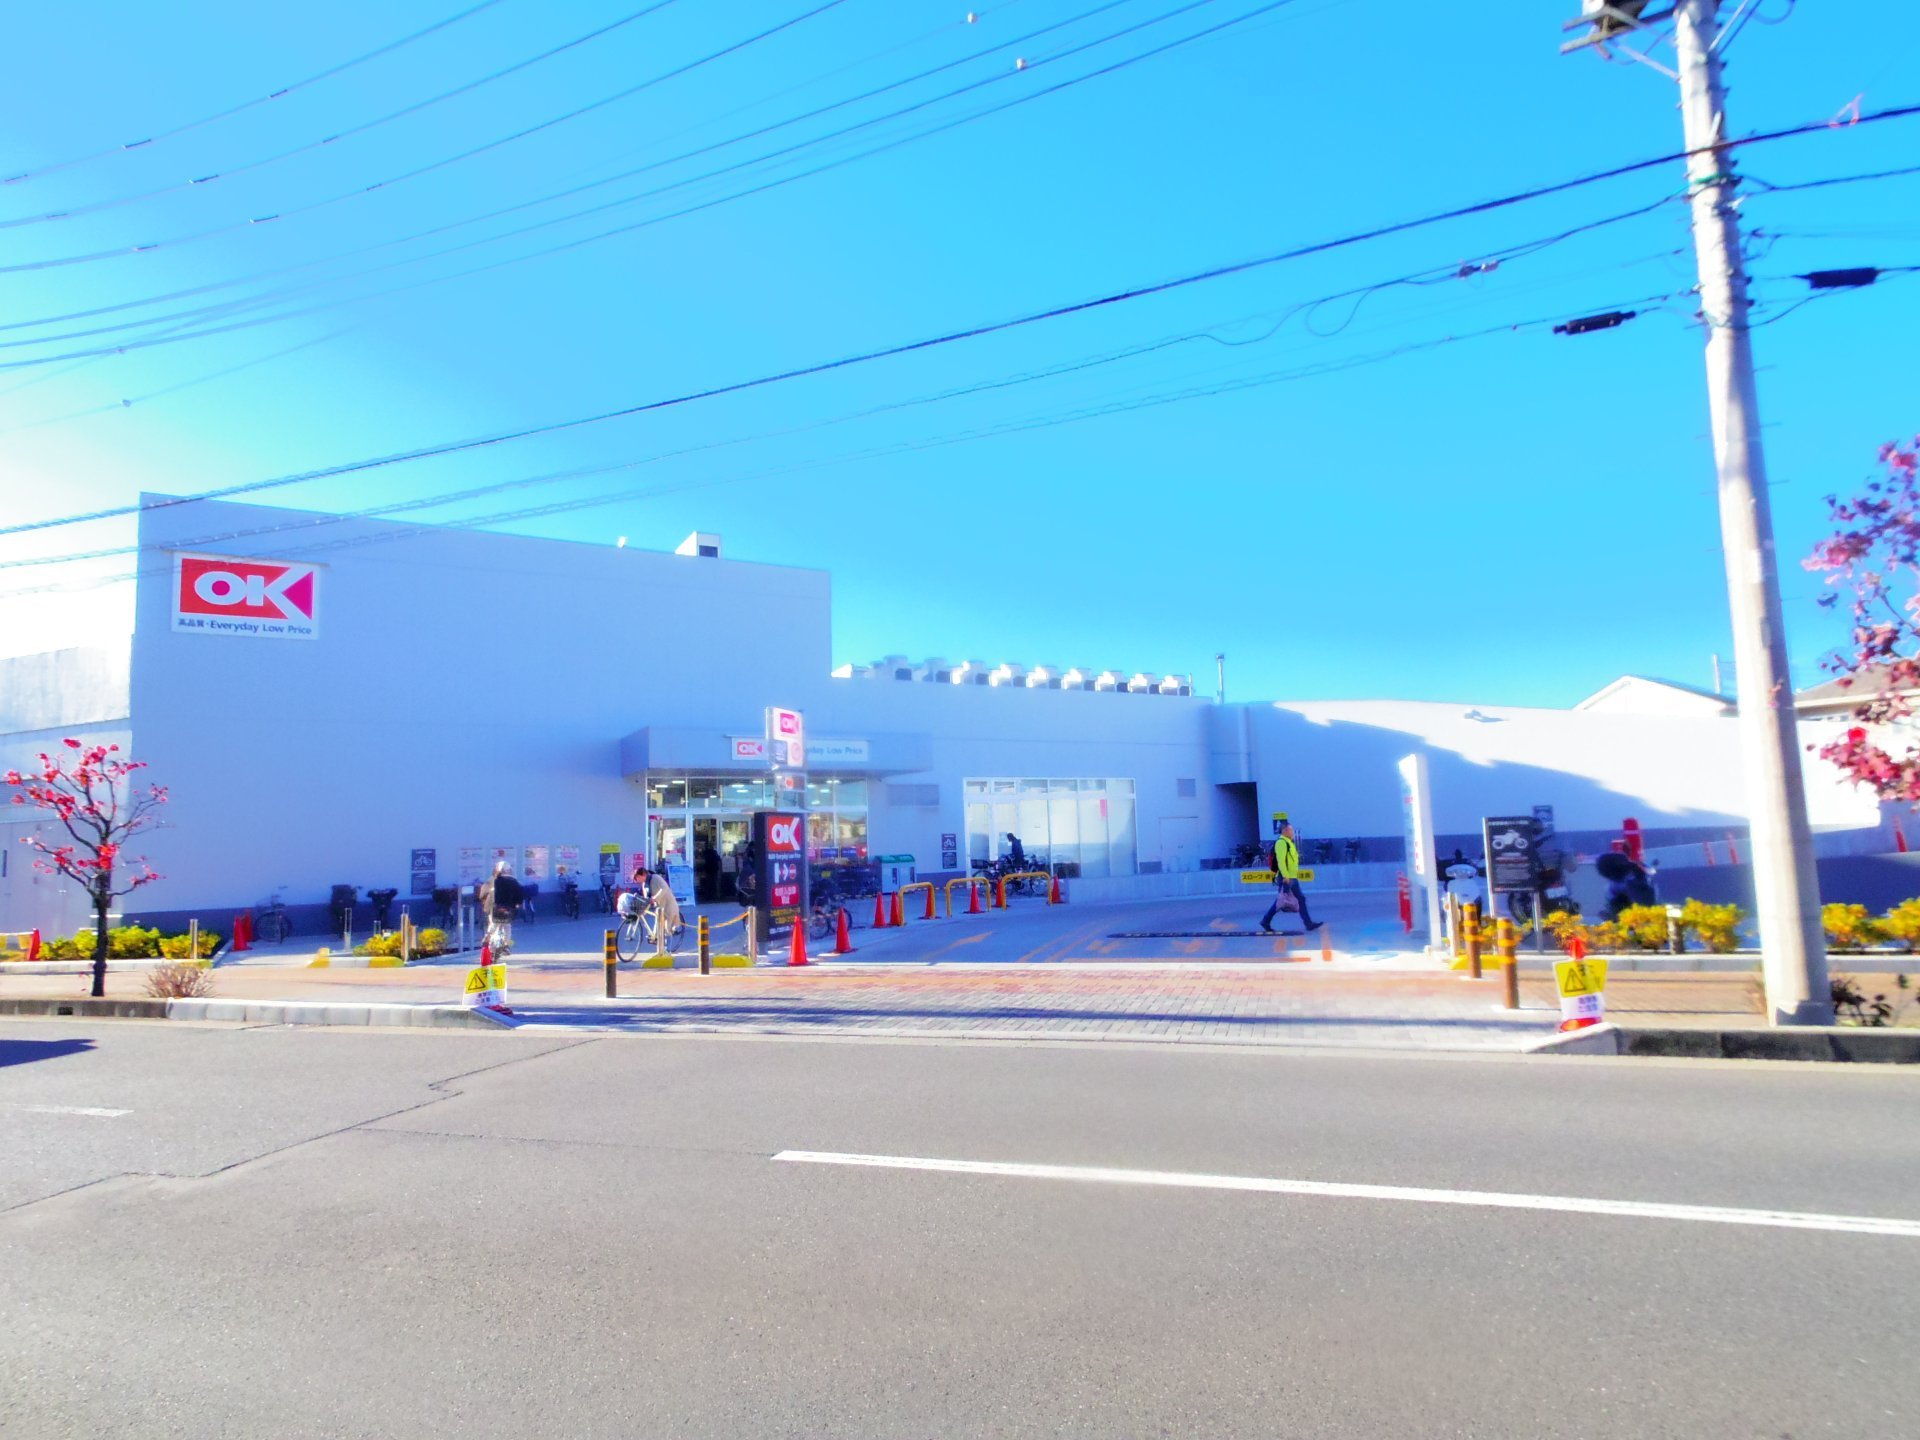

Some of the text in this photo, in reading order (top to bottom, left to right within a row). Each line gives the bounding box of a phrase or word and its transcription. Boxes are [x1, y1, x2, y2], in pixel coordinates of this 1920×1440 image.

[194, 564, 313, 621] OK
[262, 623, 285, 633] Low
[288, 625, 312, 635] Price
[781, 714, 799, 734] OK
[739, 742, 762, 755] OK
[826, 746, 842, 754] Low
[845, 746, 863, 754] Price
[771, 817, 801, 851] OK
